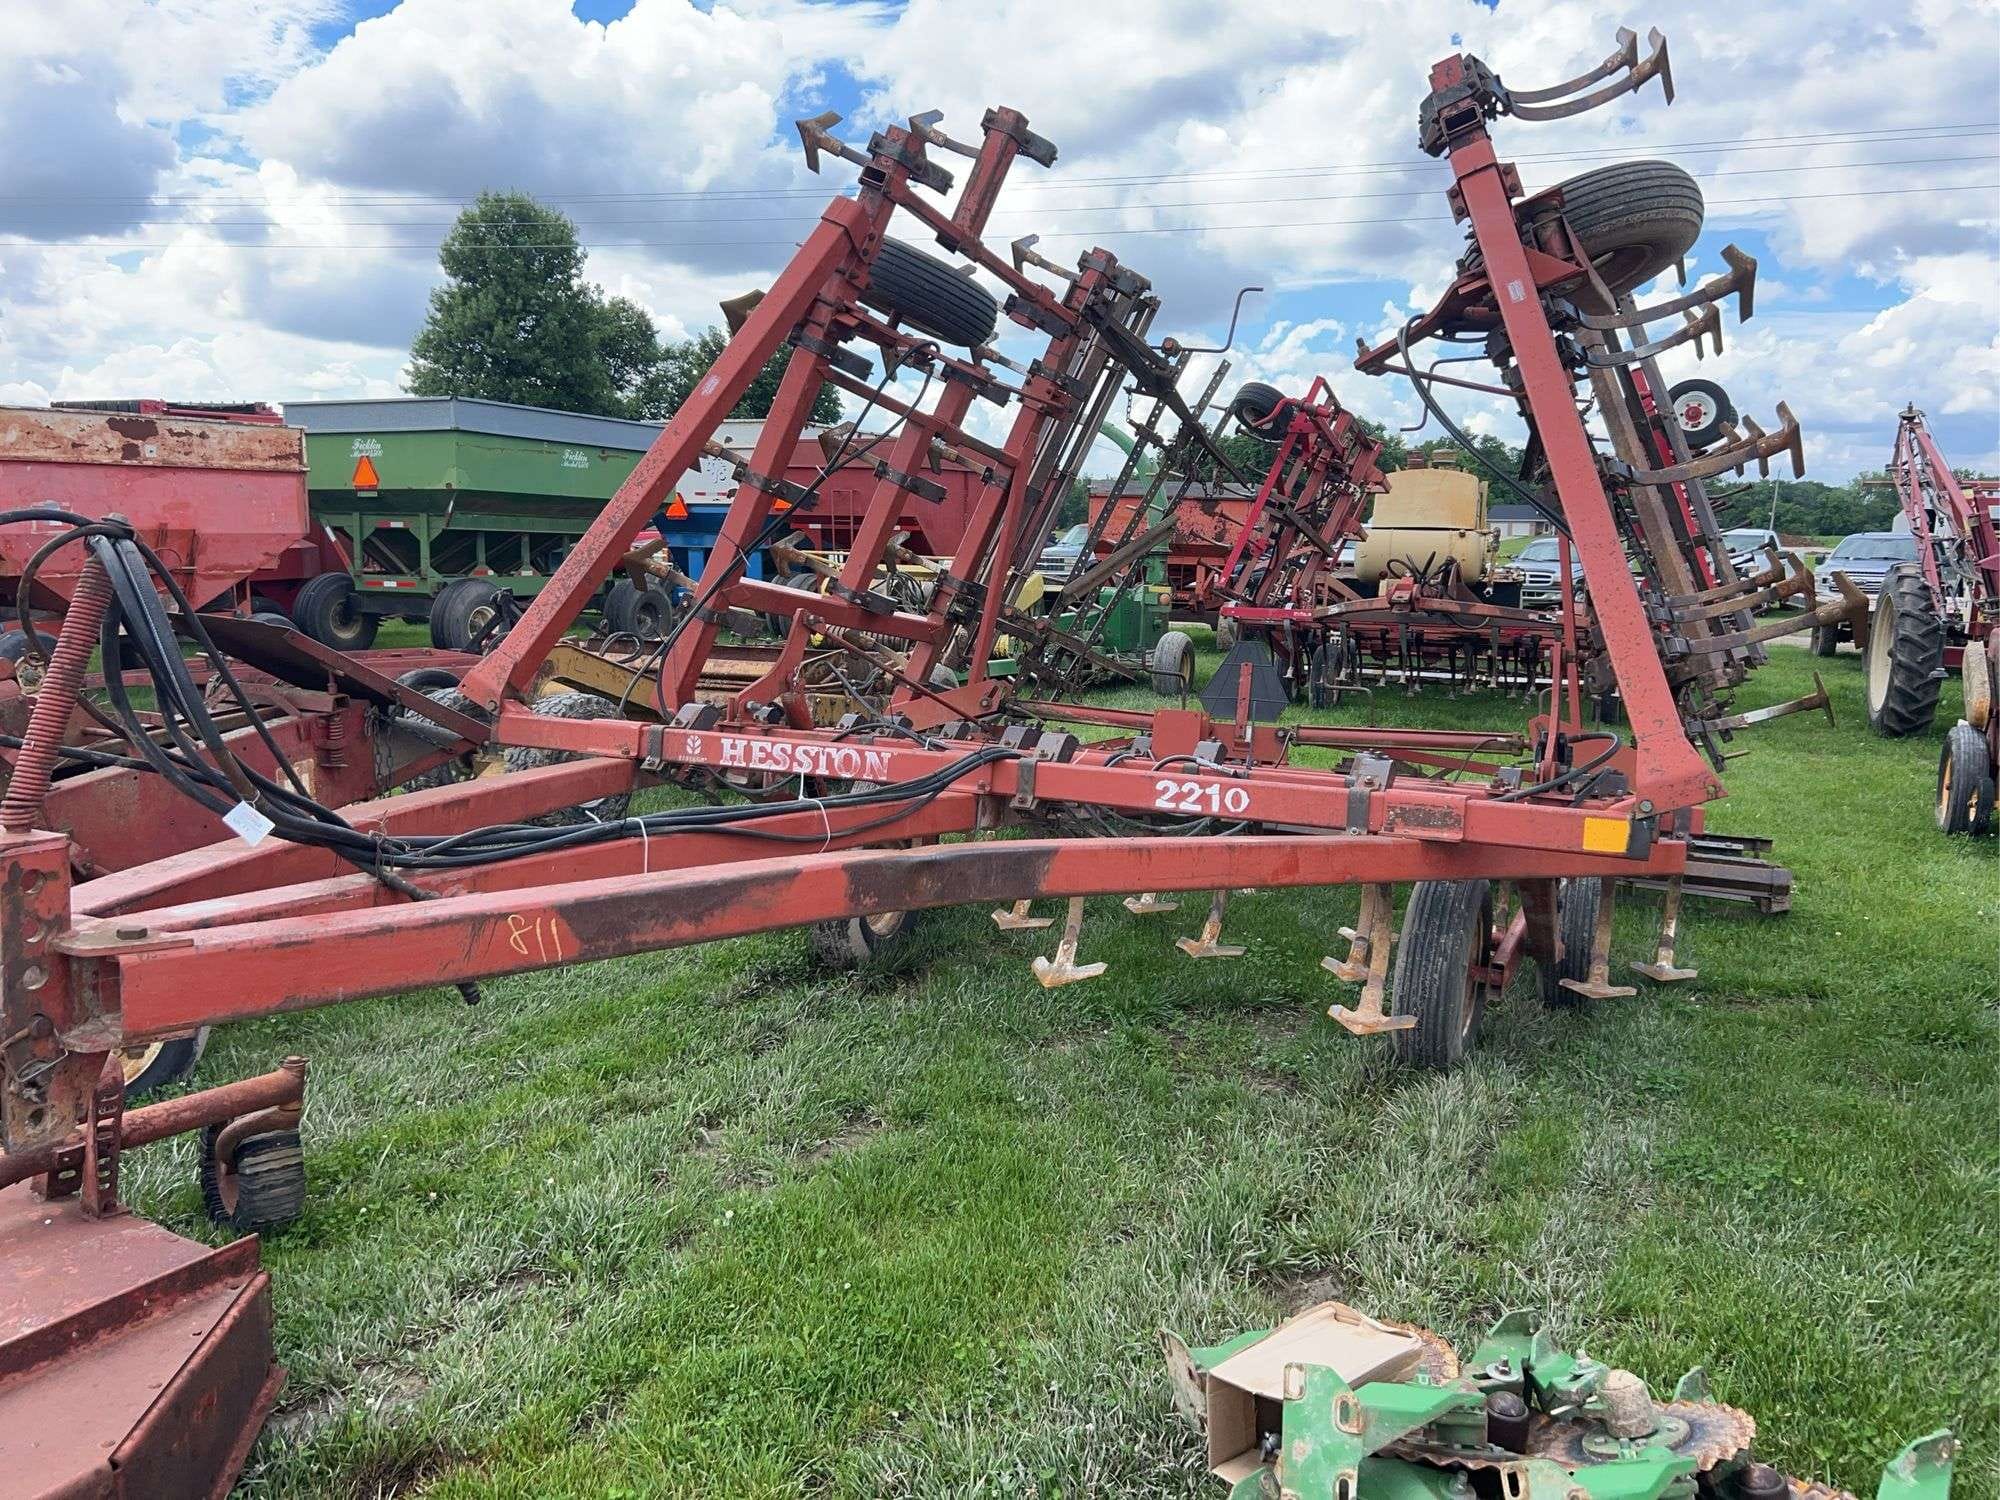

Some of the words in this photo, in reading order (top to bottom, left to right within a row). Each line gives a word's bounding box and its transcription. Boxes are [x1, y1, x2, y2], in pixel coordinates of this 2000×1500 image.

[719, 737, 892, 780] HESSTON
[1155, 779, 1250, 813] 2210
[507, 914, 562, 963] 811
